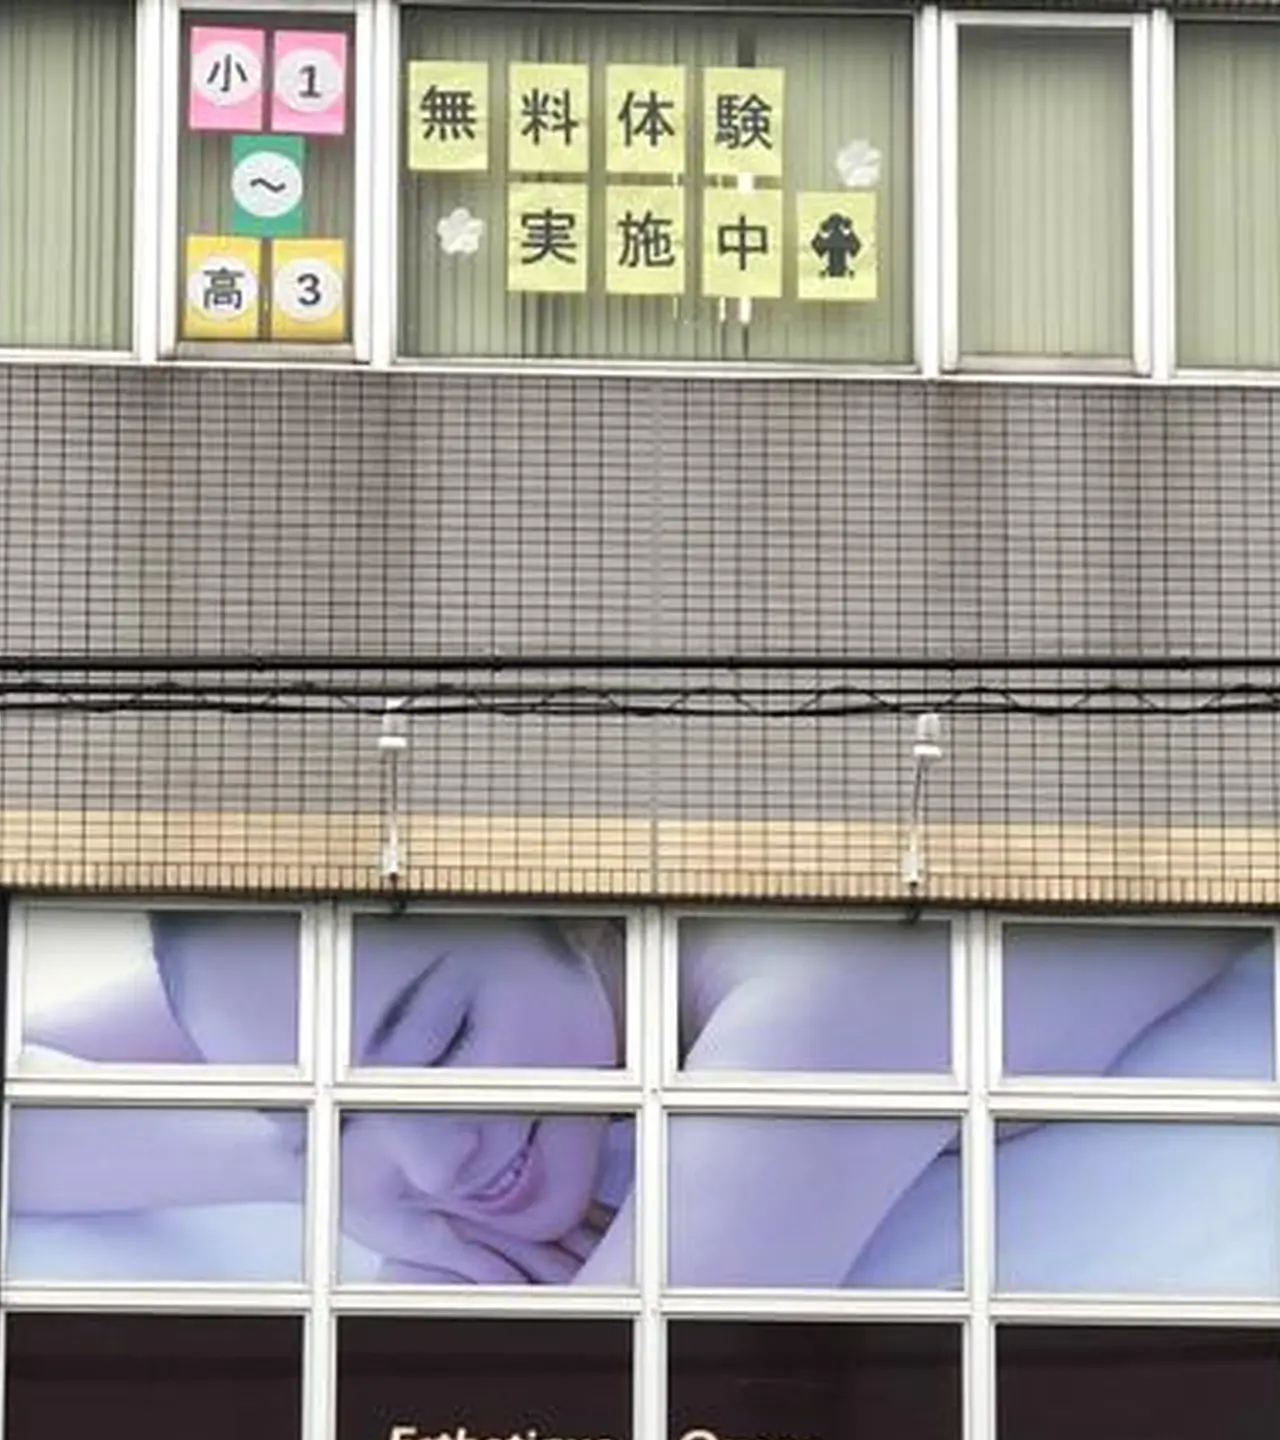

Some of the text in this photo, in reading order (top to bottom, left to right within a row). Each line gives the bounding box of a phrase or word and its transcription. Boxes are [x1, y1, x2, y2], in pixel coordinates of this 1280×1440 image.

[420, 85, 775, 152] 無料体験
[519, 208, 769, 272] 実施中
